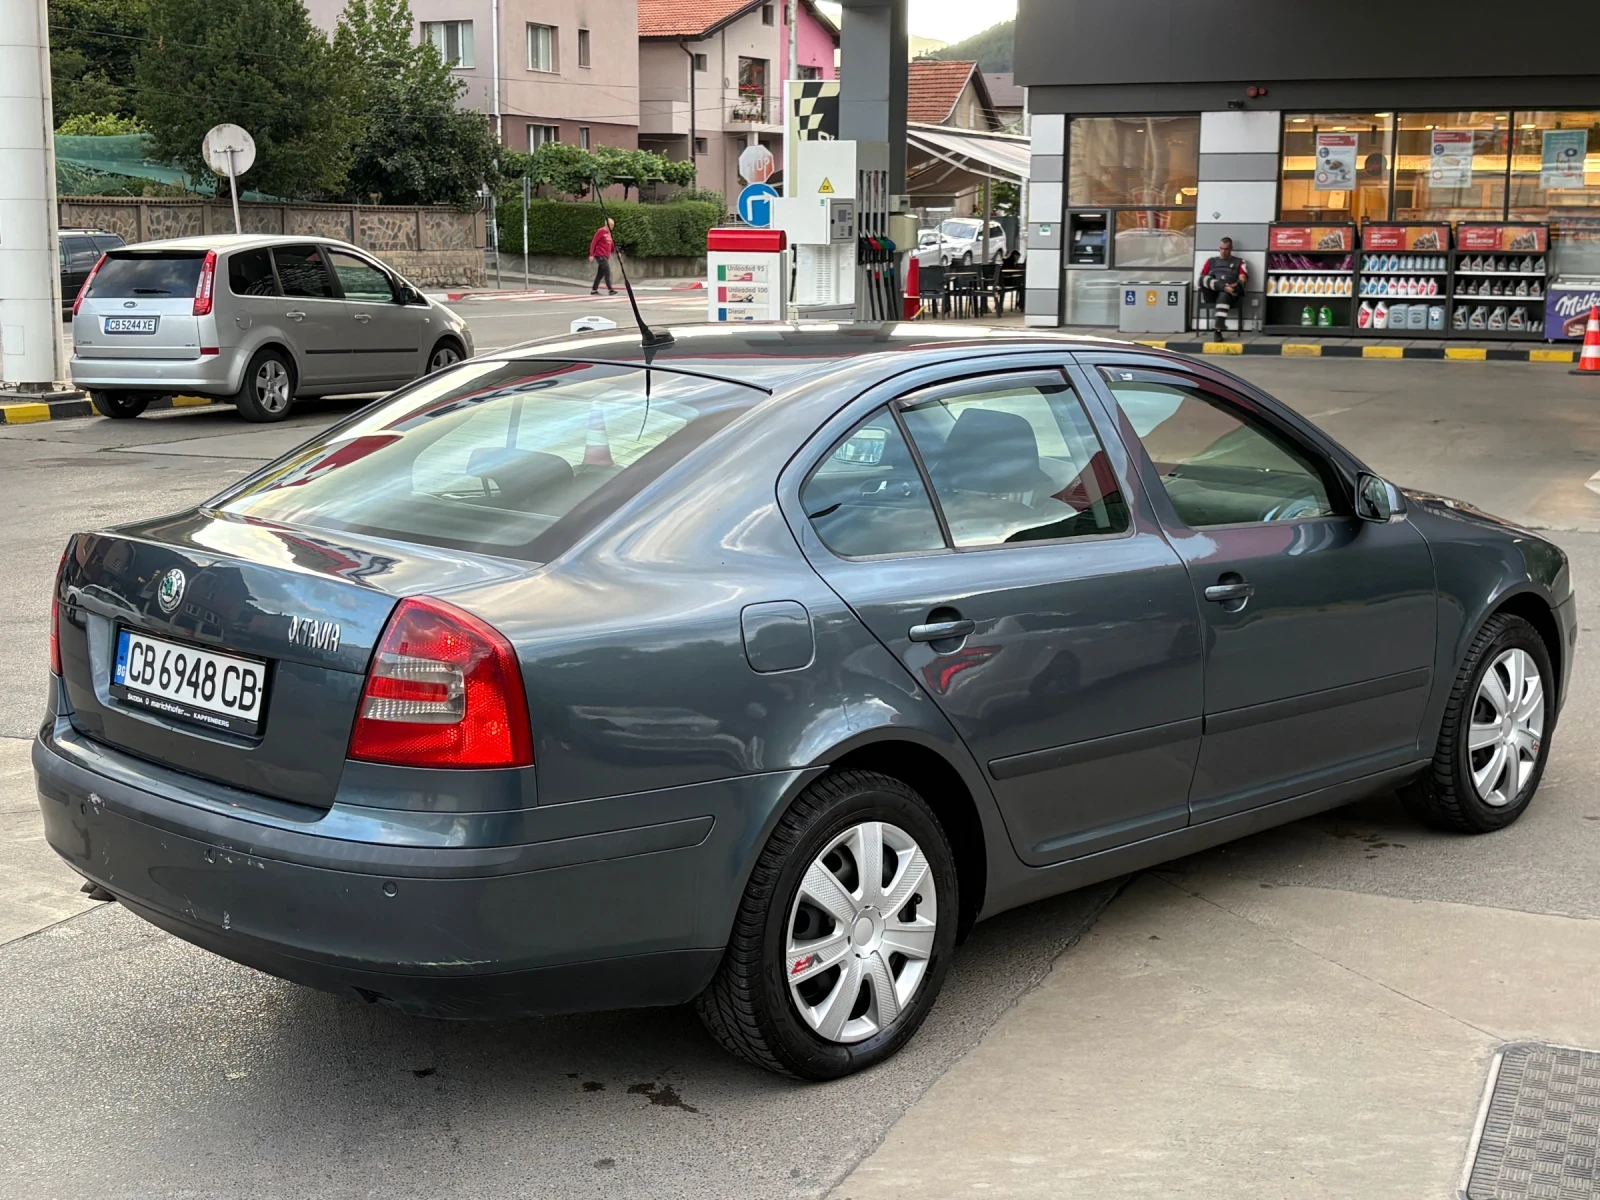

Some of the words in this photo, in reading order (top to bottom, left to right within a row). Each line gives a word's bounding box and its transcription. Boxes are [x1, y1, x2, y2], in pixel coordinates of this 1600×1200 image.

[727, 264, 755, 272] Unleaded
[1554, 292, 1600, 316] Milk
[110, 320, 121, 330] CB
[121, 320, 141, 330] 5244
[142, 320, 153, 330] XE
[116, 664, 127, 677] BG
[129, 641, 156, 685] CB
[159, 650, 217, 702] 6948
[221, 665, 257, 712] CB
[193, 712, 230, 728] KAPFENBERG
